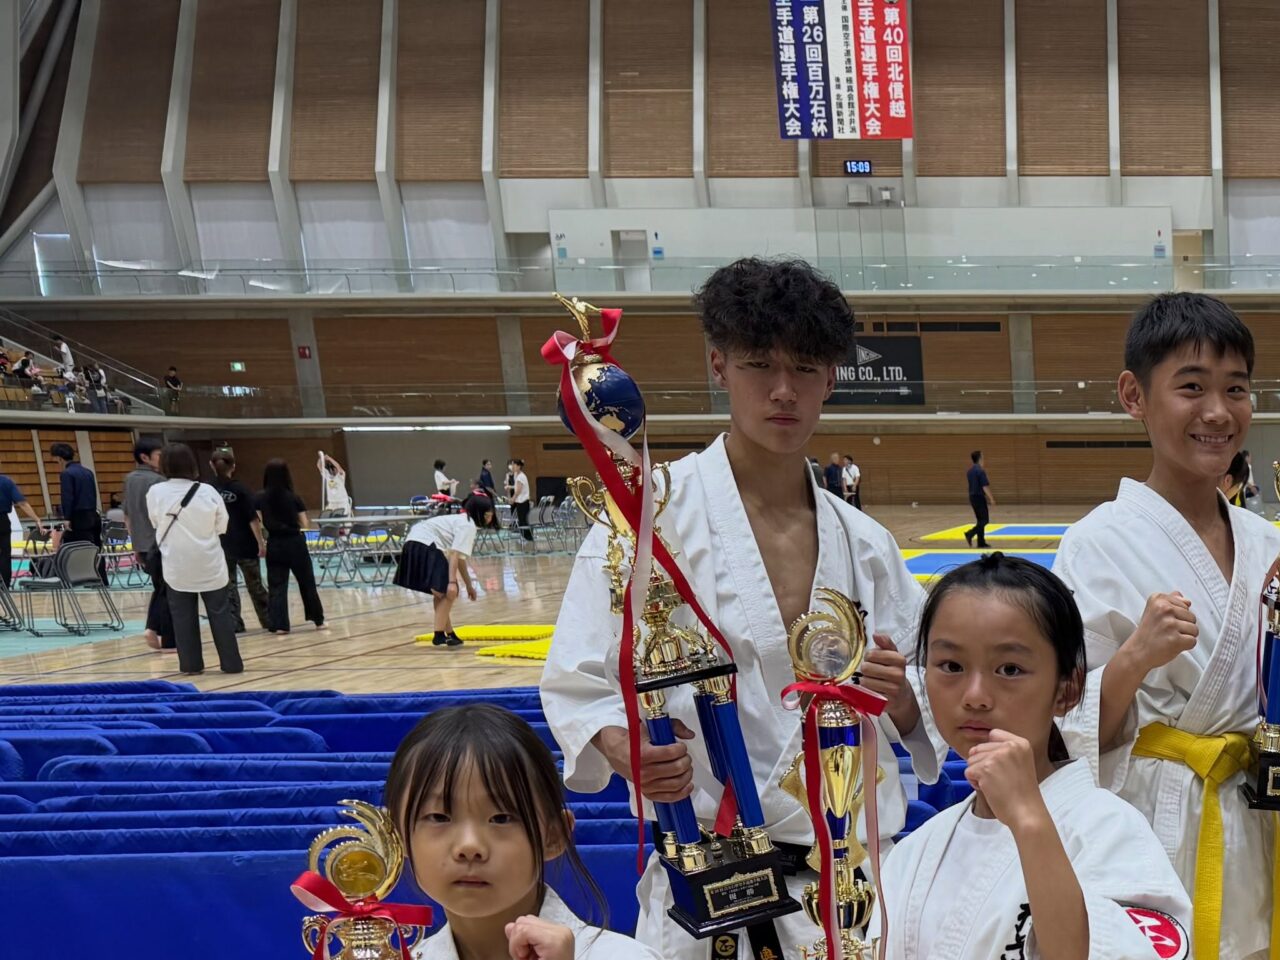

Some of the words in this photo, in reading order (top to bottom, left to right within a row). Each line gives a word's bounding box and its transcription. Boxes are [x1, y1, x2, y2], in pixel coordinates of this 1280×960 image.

[802, 6, 828, 137] 第26回百万石杯
[883, 8, 906, 118] 第40回北信越
[846, 161, 870, 173] 15:09
[882, 366, 907, 381] LTD.
